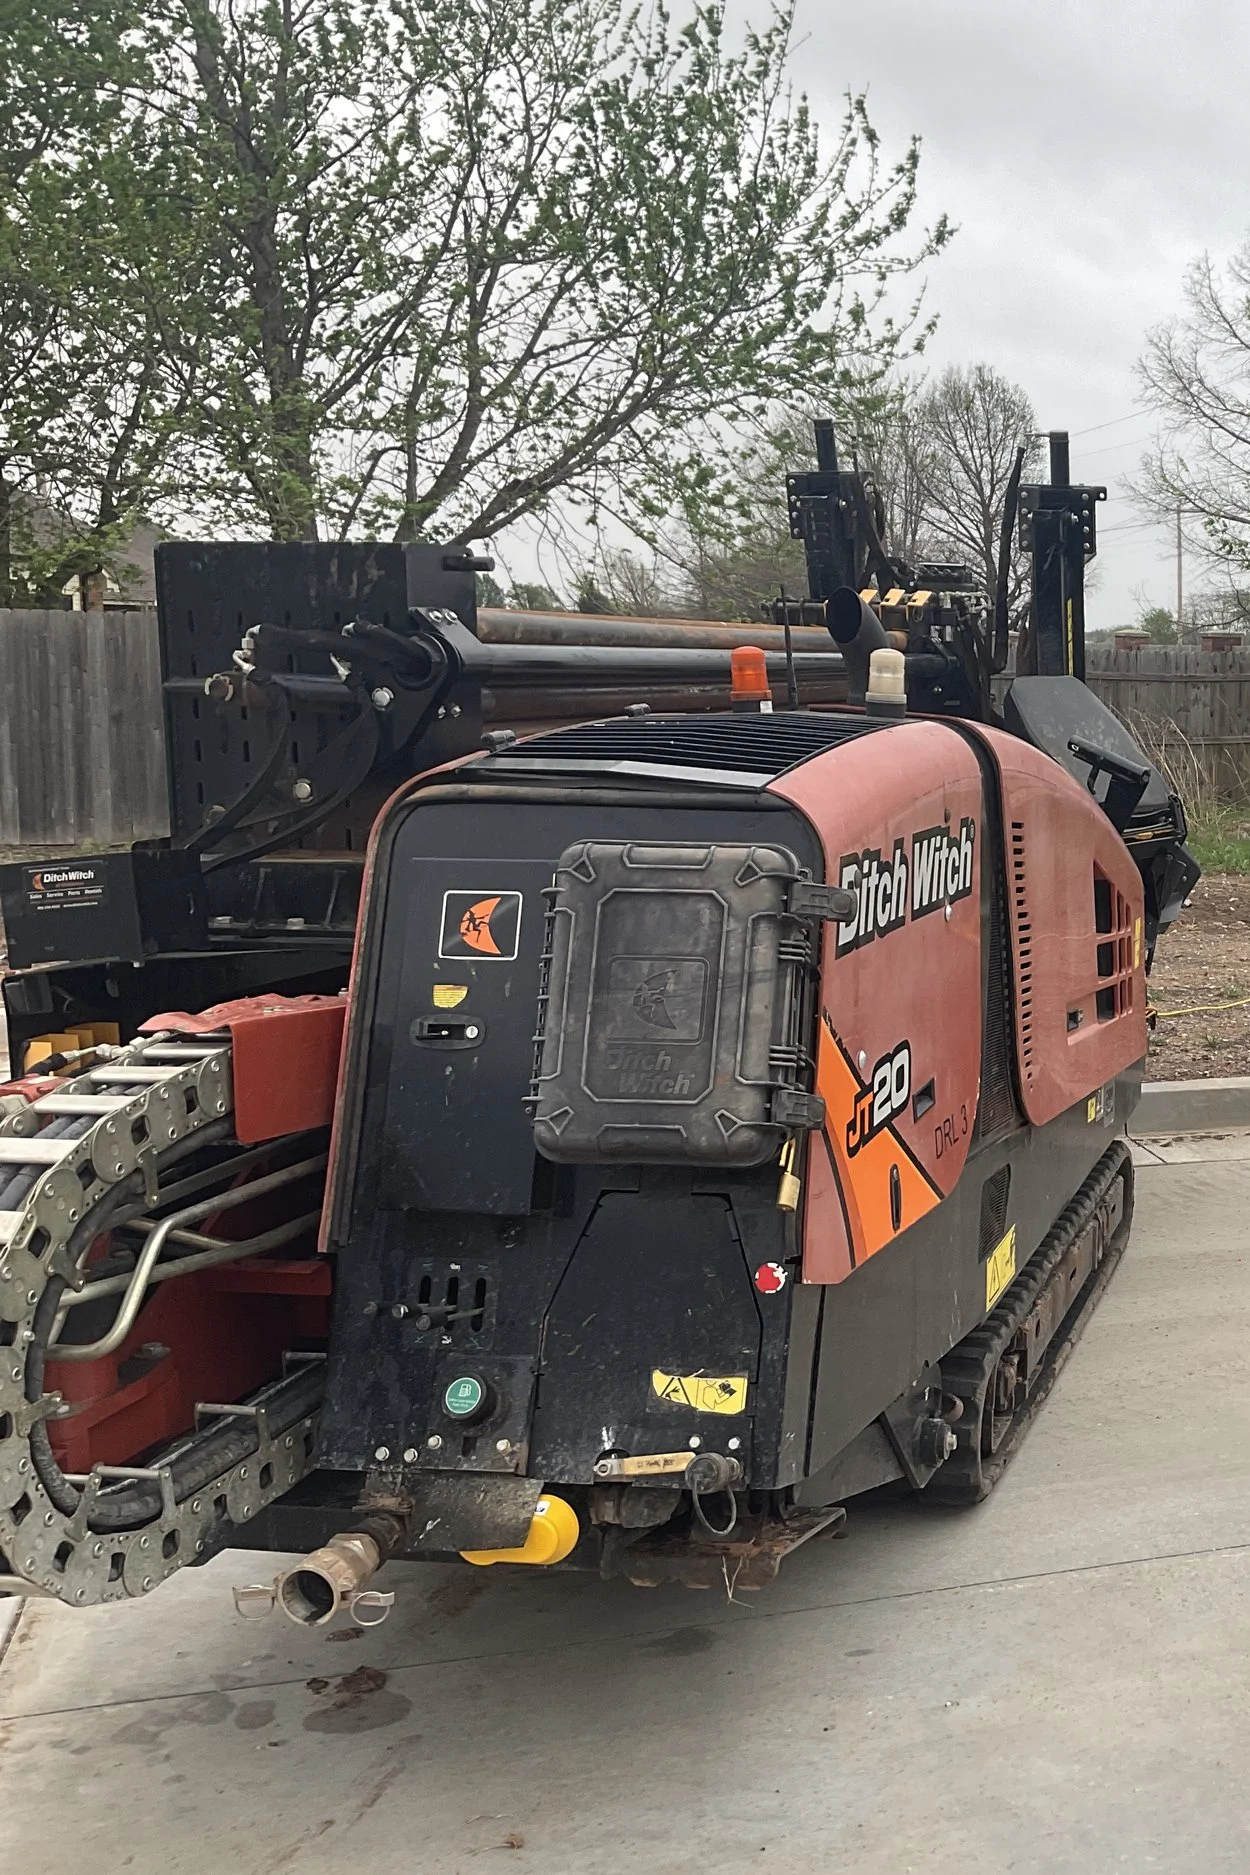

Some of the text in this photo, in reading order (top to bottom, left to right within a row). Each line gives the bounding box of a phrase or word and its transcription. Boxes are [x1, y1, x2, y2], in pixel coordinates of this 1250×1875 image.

[43, 872, 67, 883] Ditch
[68, 869, 94, 881] Witch
[838, 826, 972, 947] Ditch Witch
[848, 1048, 909, 1149] JT20
[934, 1103, 968, 1160] DRL 3
